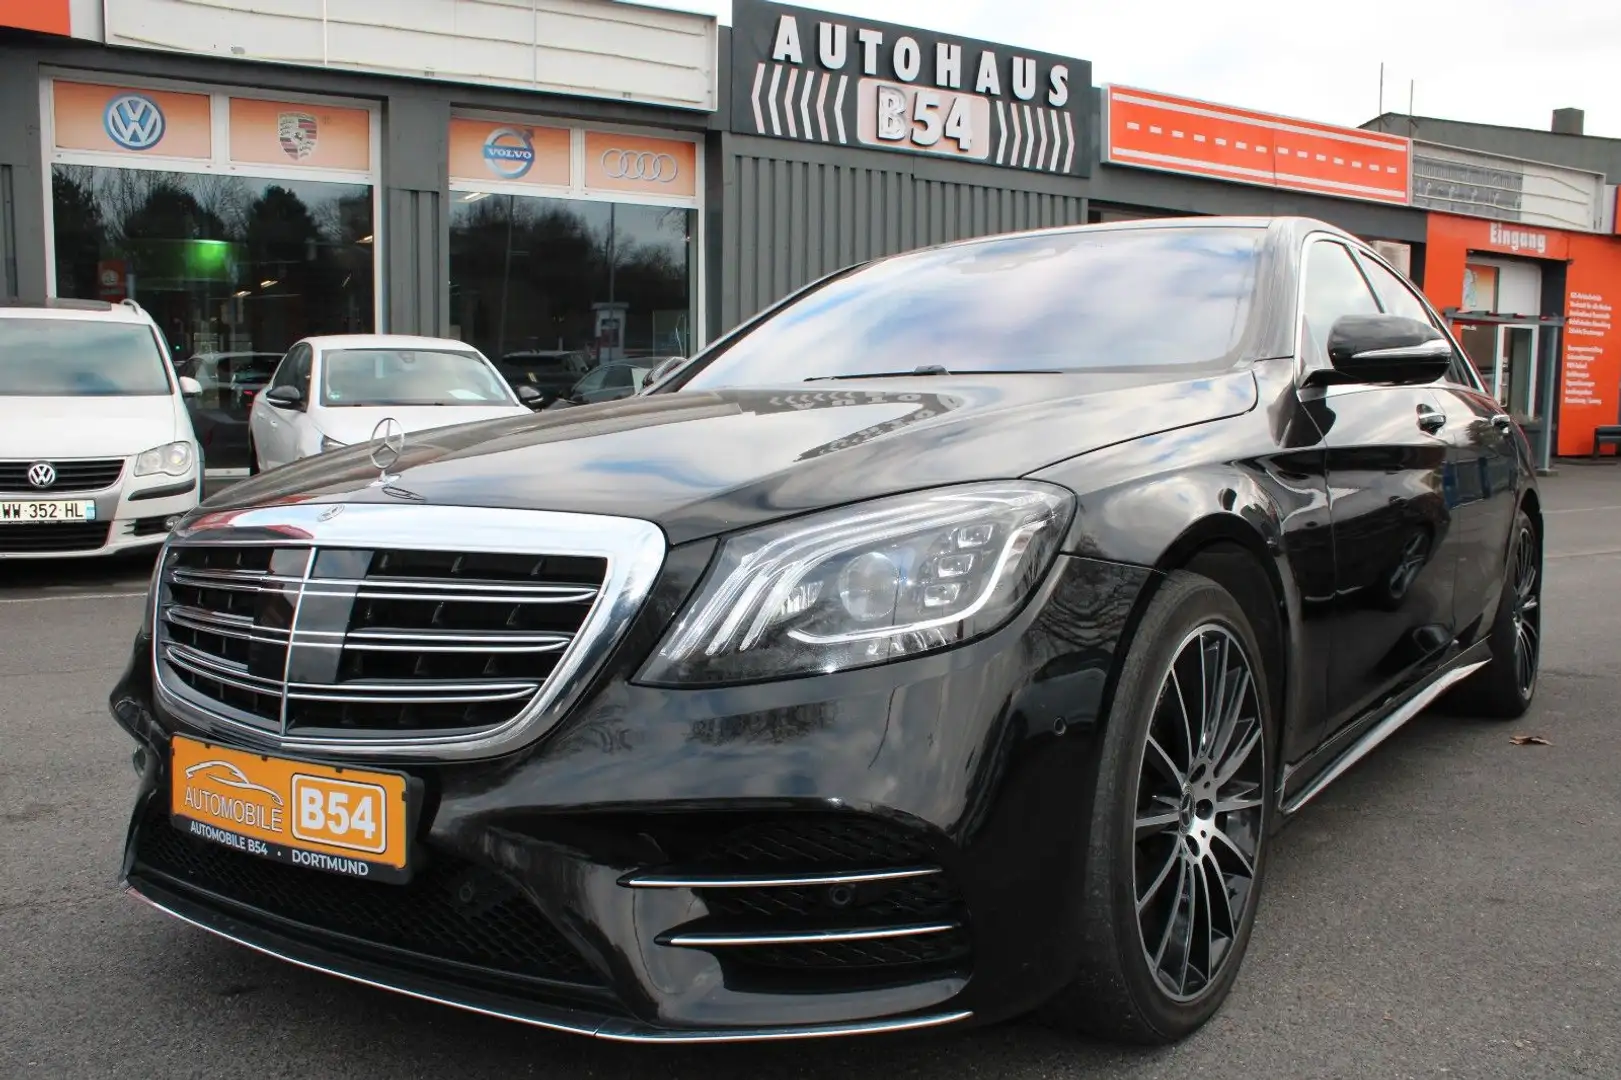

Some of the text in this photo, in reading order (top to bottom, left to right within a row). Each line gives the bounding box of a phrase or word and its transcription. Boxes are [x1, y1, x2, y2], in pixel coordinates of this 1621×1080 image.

[772, 15, 1069, 107] AUTOHAUS
[876, 85, 973, 151] B54
[487, 148, 532, 159] VOLVO
[1489, 223, 1546, 253] Eingang
[184, 786, 283, 833] AUTOMOBILE
[300, 786, 376, 839] B54
[190, 820, 369, 876] AUTOMOBILE B54 DORTMUND
